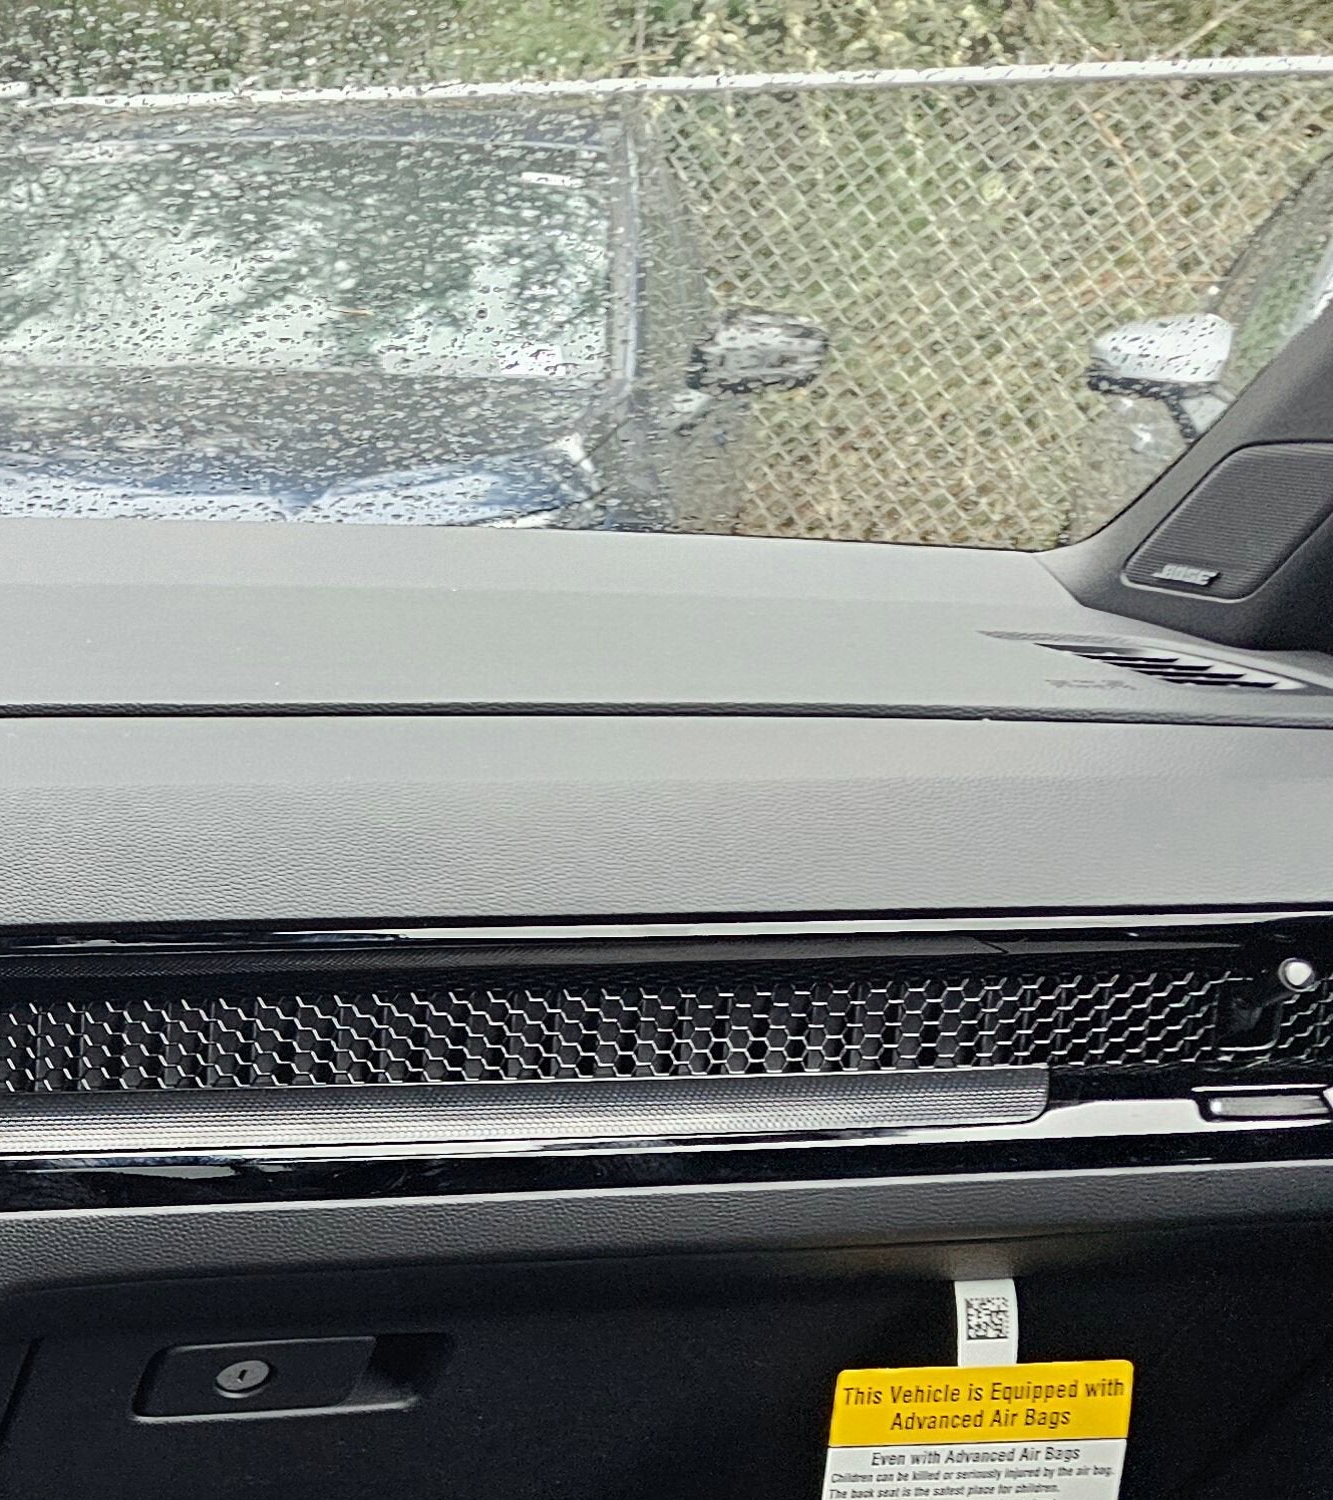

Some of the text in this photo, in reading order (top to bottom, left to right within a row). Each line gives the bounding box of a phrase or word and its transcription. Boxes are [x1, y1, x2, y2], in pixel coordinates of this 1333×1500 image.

[1152, 563, 1220, 586] BOSE
[843, 1378, 1125, 1406] This Vehicle is Equipped with
[890, 1408, 1072, 1431] Advanced Air Bags
[871, 1446, 1081, 1466] Even with Advanced Air Bags
[831, 1465, 1115, 1484] Children can be killed or seriously injured by the air bag.
[829, 1483, 1060, 1500] The back seat is the safest place for children.
